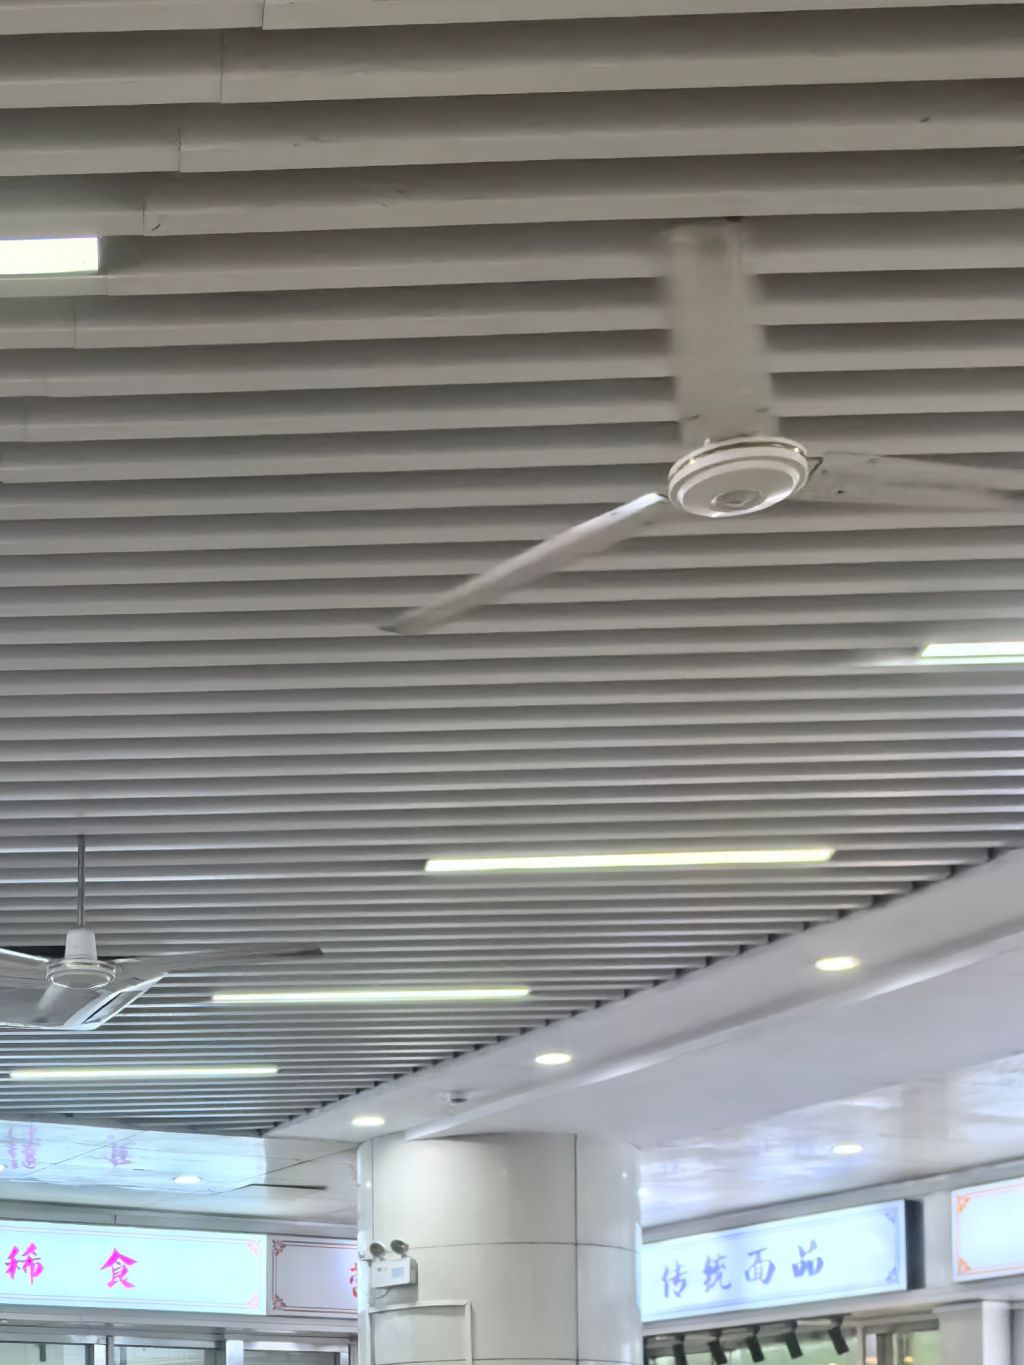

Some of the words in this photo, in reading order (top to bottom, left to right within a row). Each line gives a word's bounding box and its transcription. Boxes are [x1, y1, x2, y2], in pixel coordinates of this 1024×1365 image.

[5, 1242, 138, 1289] 稀食
[662, 1240, 824, 1298] 传统面品
